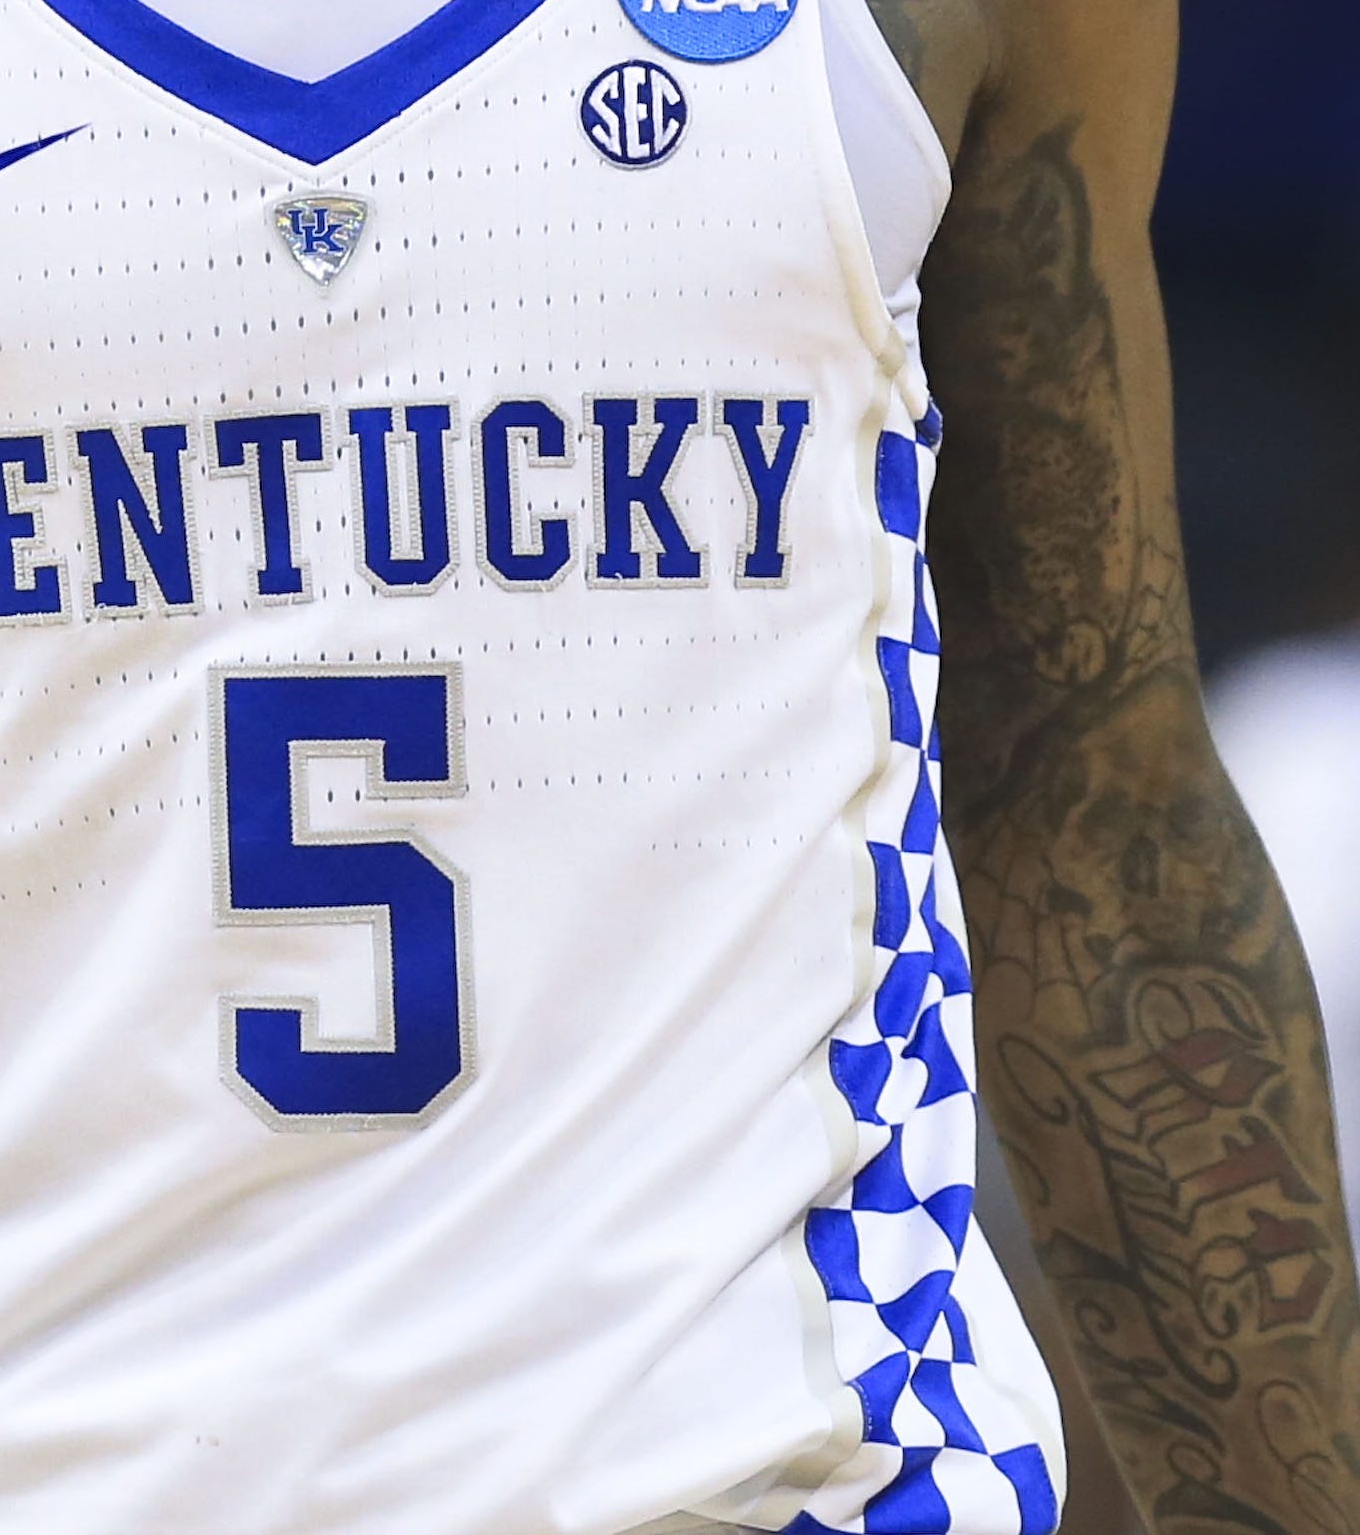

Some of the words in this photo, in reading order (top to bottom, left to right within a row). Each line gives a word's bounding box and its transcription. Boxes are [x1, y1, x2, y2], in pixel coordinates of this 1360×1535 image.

[588, 66, 681, 159] SEC
[287, 208, 346, 253] UK
[207, 662, 477, 1133] 5
